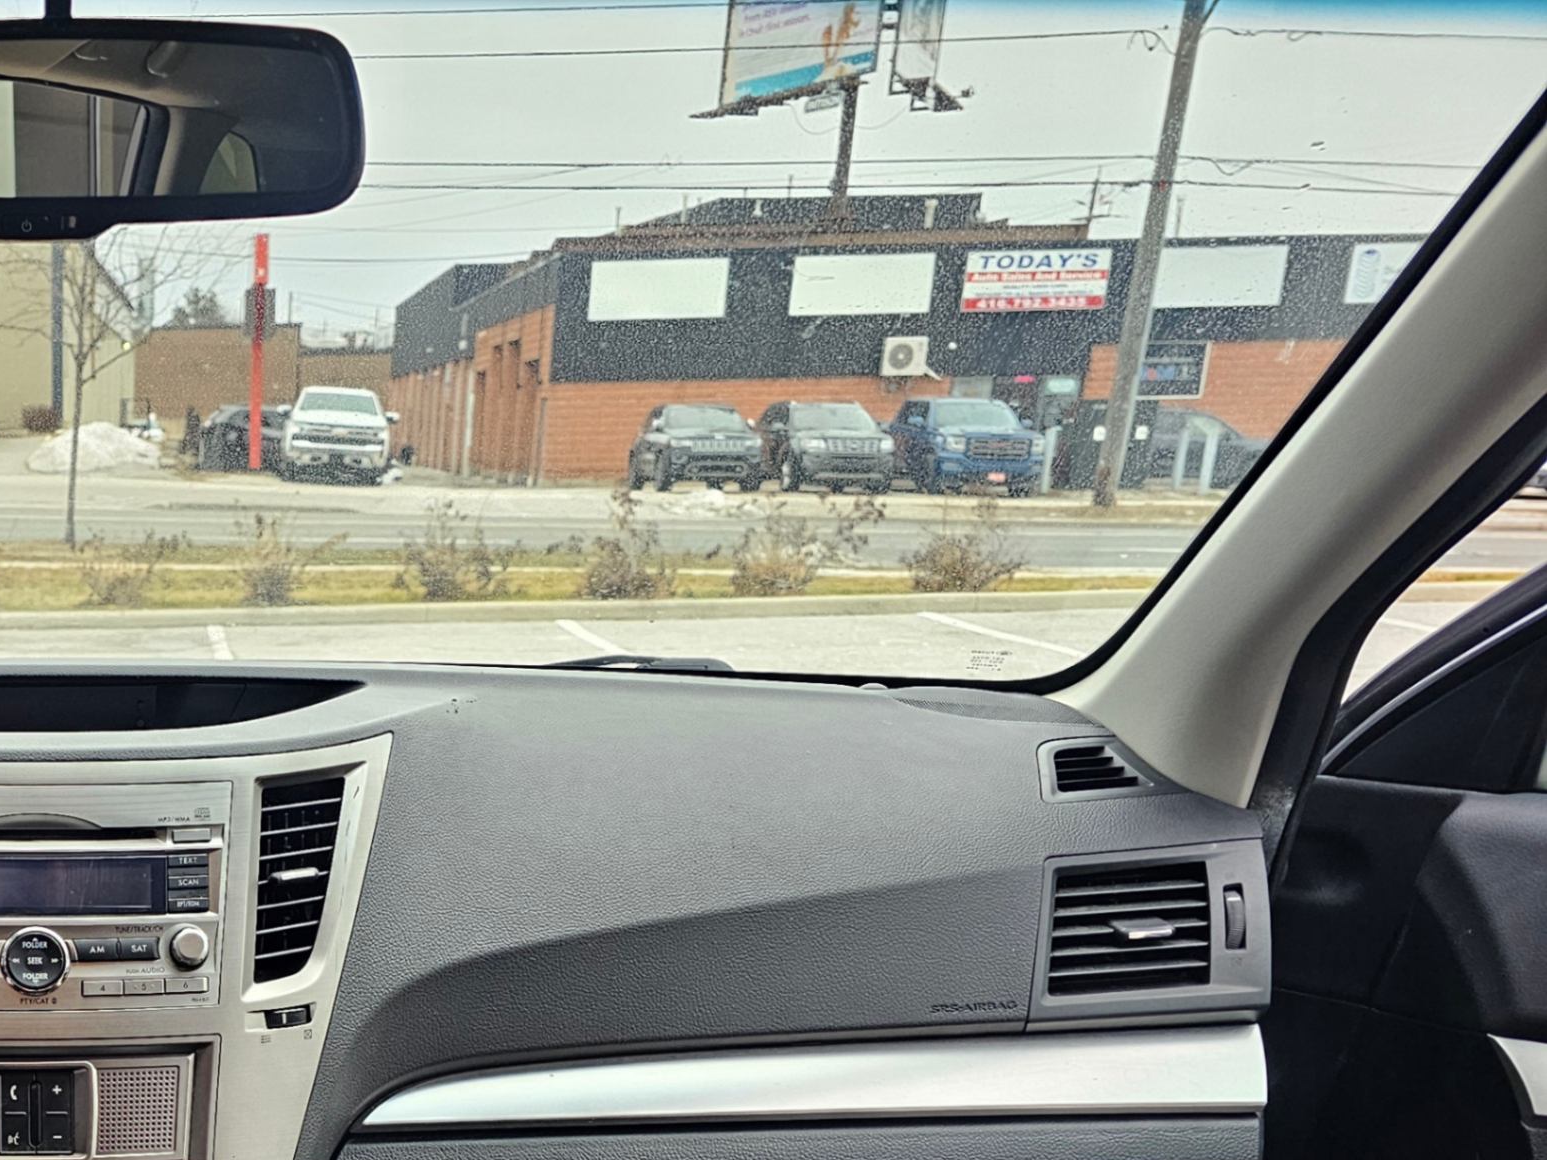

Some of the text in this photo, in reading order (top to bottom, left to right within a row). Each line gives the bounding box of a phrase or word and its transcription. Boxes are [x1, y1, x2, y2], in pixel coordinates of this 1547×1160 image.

[980, 253, 1098, 269] TODAY'S
[178, 857, 197, 865] TEXT
[177, 879, 199, 887] SCAN
[22, 941, 48, 949] FOLDER
[131, 944, 148, 953] SAT
[89, 945, 105, 954] AM
[26, 956, 43, 965] SEEK
[141, 966, 166, 974] AUDIO
[22, 972, 49, 980] FOLDER
[141, 983, 147, 991] 5
[183, 981, 189, 989] 6
[20, 997, 49, 1005] PTY/CAT
